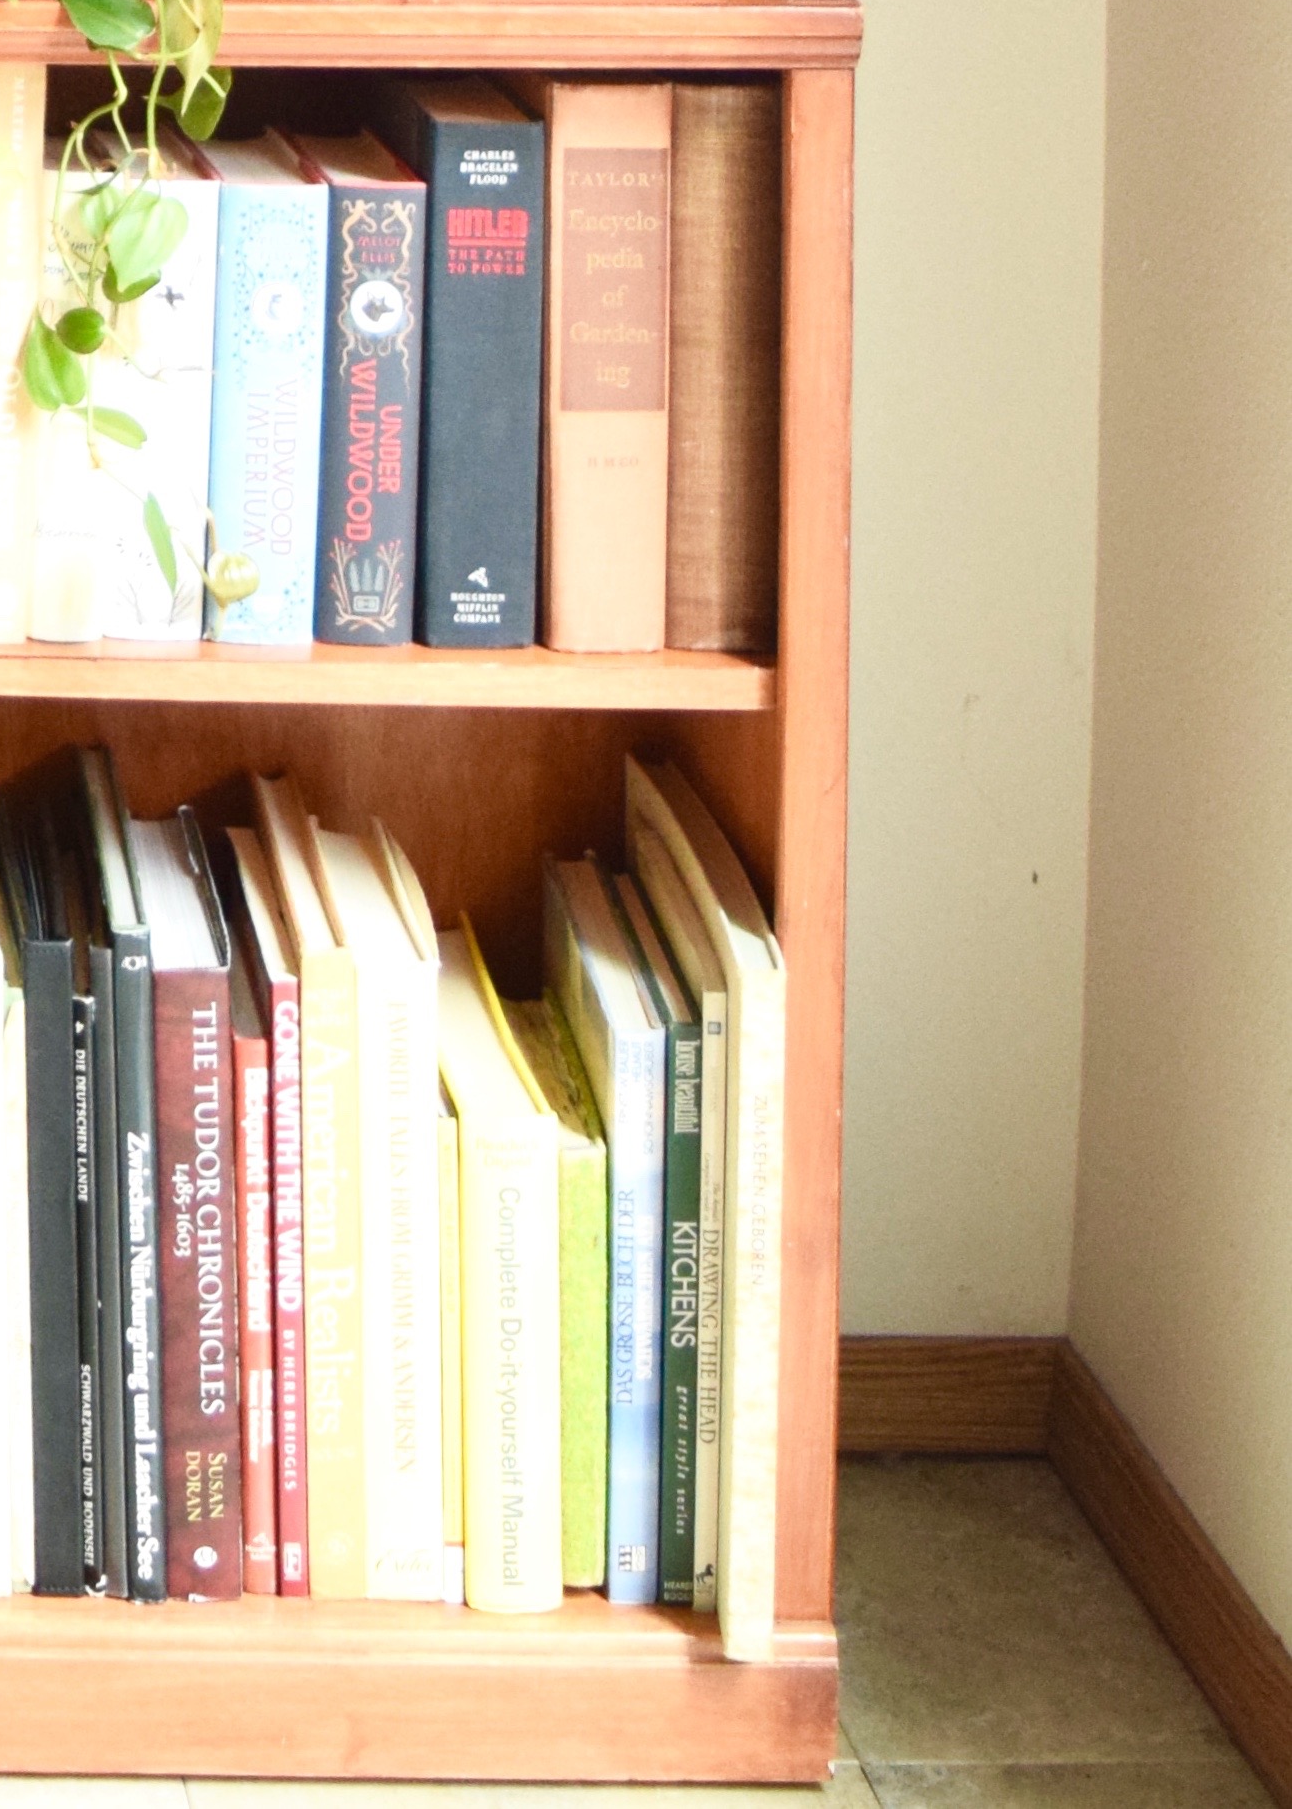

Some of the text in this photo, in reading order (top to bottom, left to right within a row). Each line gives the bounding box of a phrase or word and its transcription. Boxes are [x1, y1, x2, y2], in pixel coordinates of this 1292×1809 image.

[459, 162, 519, 174] BRACELEN
[463, 150, 516, 161] CHARLES
[469, 174, 509, 185] FLOOD
[447, 207, 530, 238] HITLER
[448, 249, 526, 261] THE PATH
[448, 262, 526, 276] TO POWER
[585, 247, 646, 275] pedia
[570, 321, 661, 344] Garden-
[602, 284, 630, 309] of
[595, 362, 633, 389] ing
[242, 392, 271, 550] IMPERIUM
[269, 378, 299, 557] WILDWOOD
[346, 359, 378, 543] WILDWOOD
[377, 404, 403, 494] UNDER
[450, 592, 506, 603] HOUGHTON
[453, 613, 502, 624] COMPANY
[457, 603, 499, 613] MIFFLIN
[75, 1049, 90, 1204] DIE DEUTSCHEN LANDE
[674, 1040, 702, 1135] house beautiful
[274, 1000, 303, 1312] GONE WITH THE WIND
[307, 1036, 352, 1255] American
[171, 1162, 194, 1259] 1485-1603
[192, 1001, 227, 1416] THE TUDOR CHRONICLES
[240, 1066, 272, 1333] Blickpunkt Deutschland
[750, 1142, 768, 1287] SEHEN GEBOREN
[670, 1220, 698, 1350] KITCHENS
[125, 1131, 161, 1581] Zwischen Nürburgring und See
[615, 1294, 634, 1405] DAS GROSSE
[699, 1228, 721, 1445] DRAWING THE HEAD
[283, 1328, 298, 1492] BY HERB BRIDGES
[495, 1187, 527, 1588] Complete Do-it-yourself Manual
[675, 1385, 691, 1480] great style
[80, 1364, 96, 1566] SCHWARZWALD UND BODENSEE
[185, 1450, 203, 1523] DORAN
[207, 1452, 228, 1519] SUSAN
